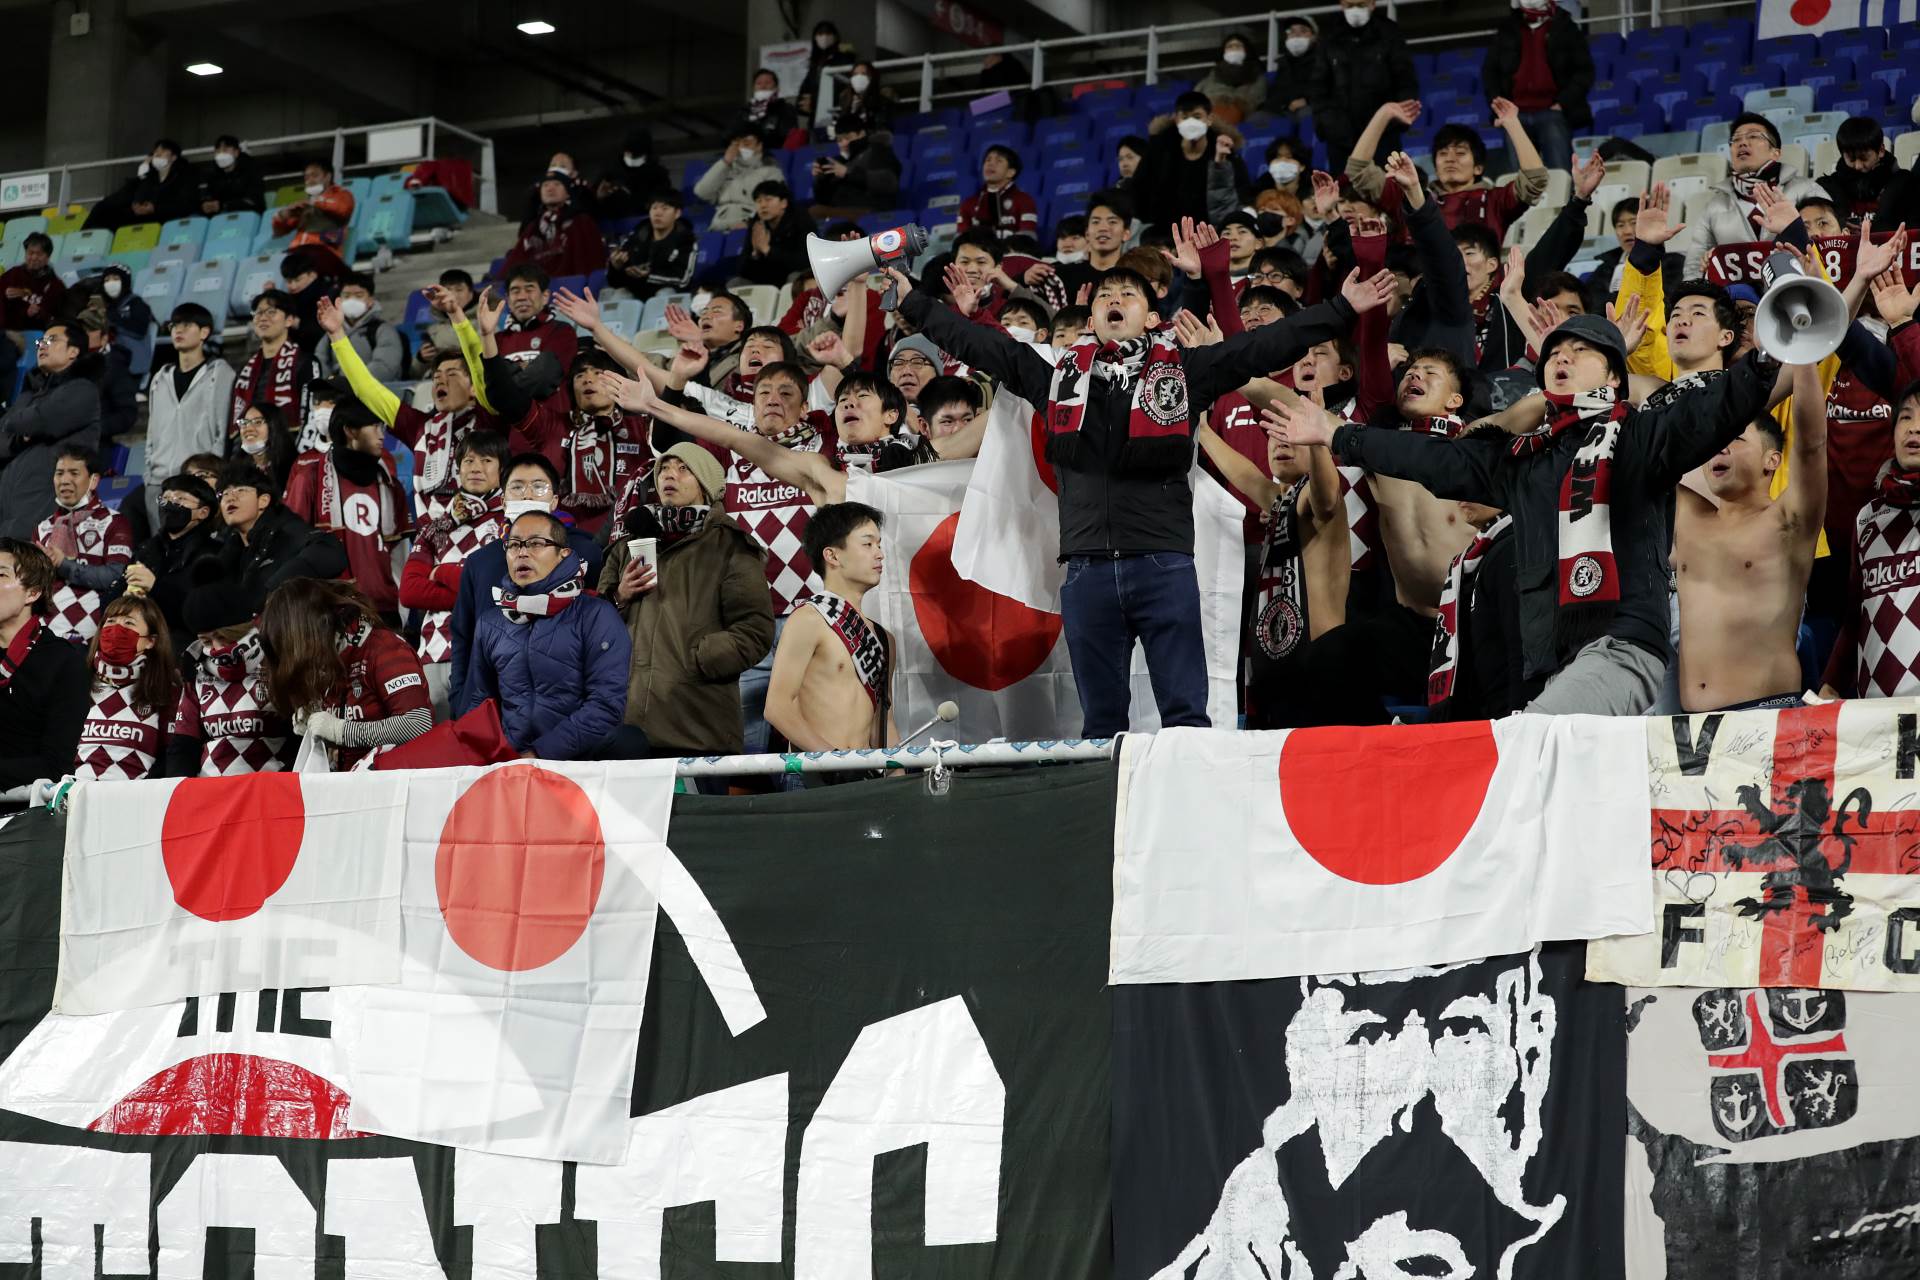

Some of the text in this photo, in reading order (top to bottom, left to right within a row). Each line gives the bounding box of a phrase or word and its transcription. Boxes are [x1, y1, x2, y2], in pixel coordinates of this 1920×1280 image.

[1825, 250, 1841, 283] 8
[356, 502, 371, 526] R
[1672, 714, 1725, 776] V
[1661, 903, 1705, 968] F
